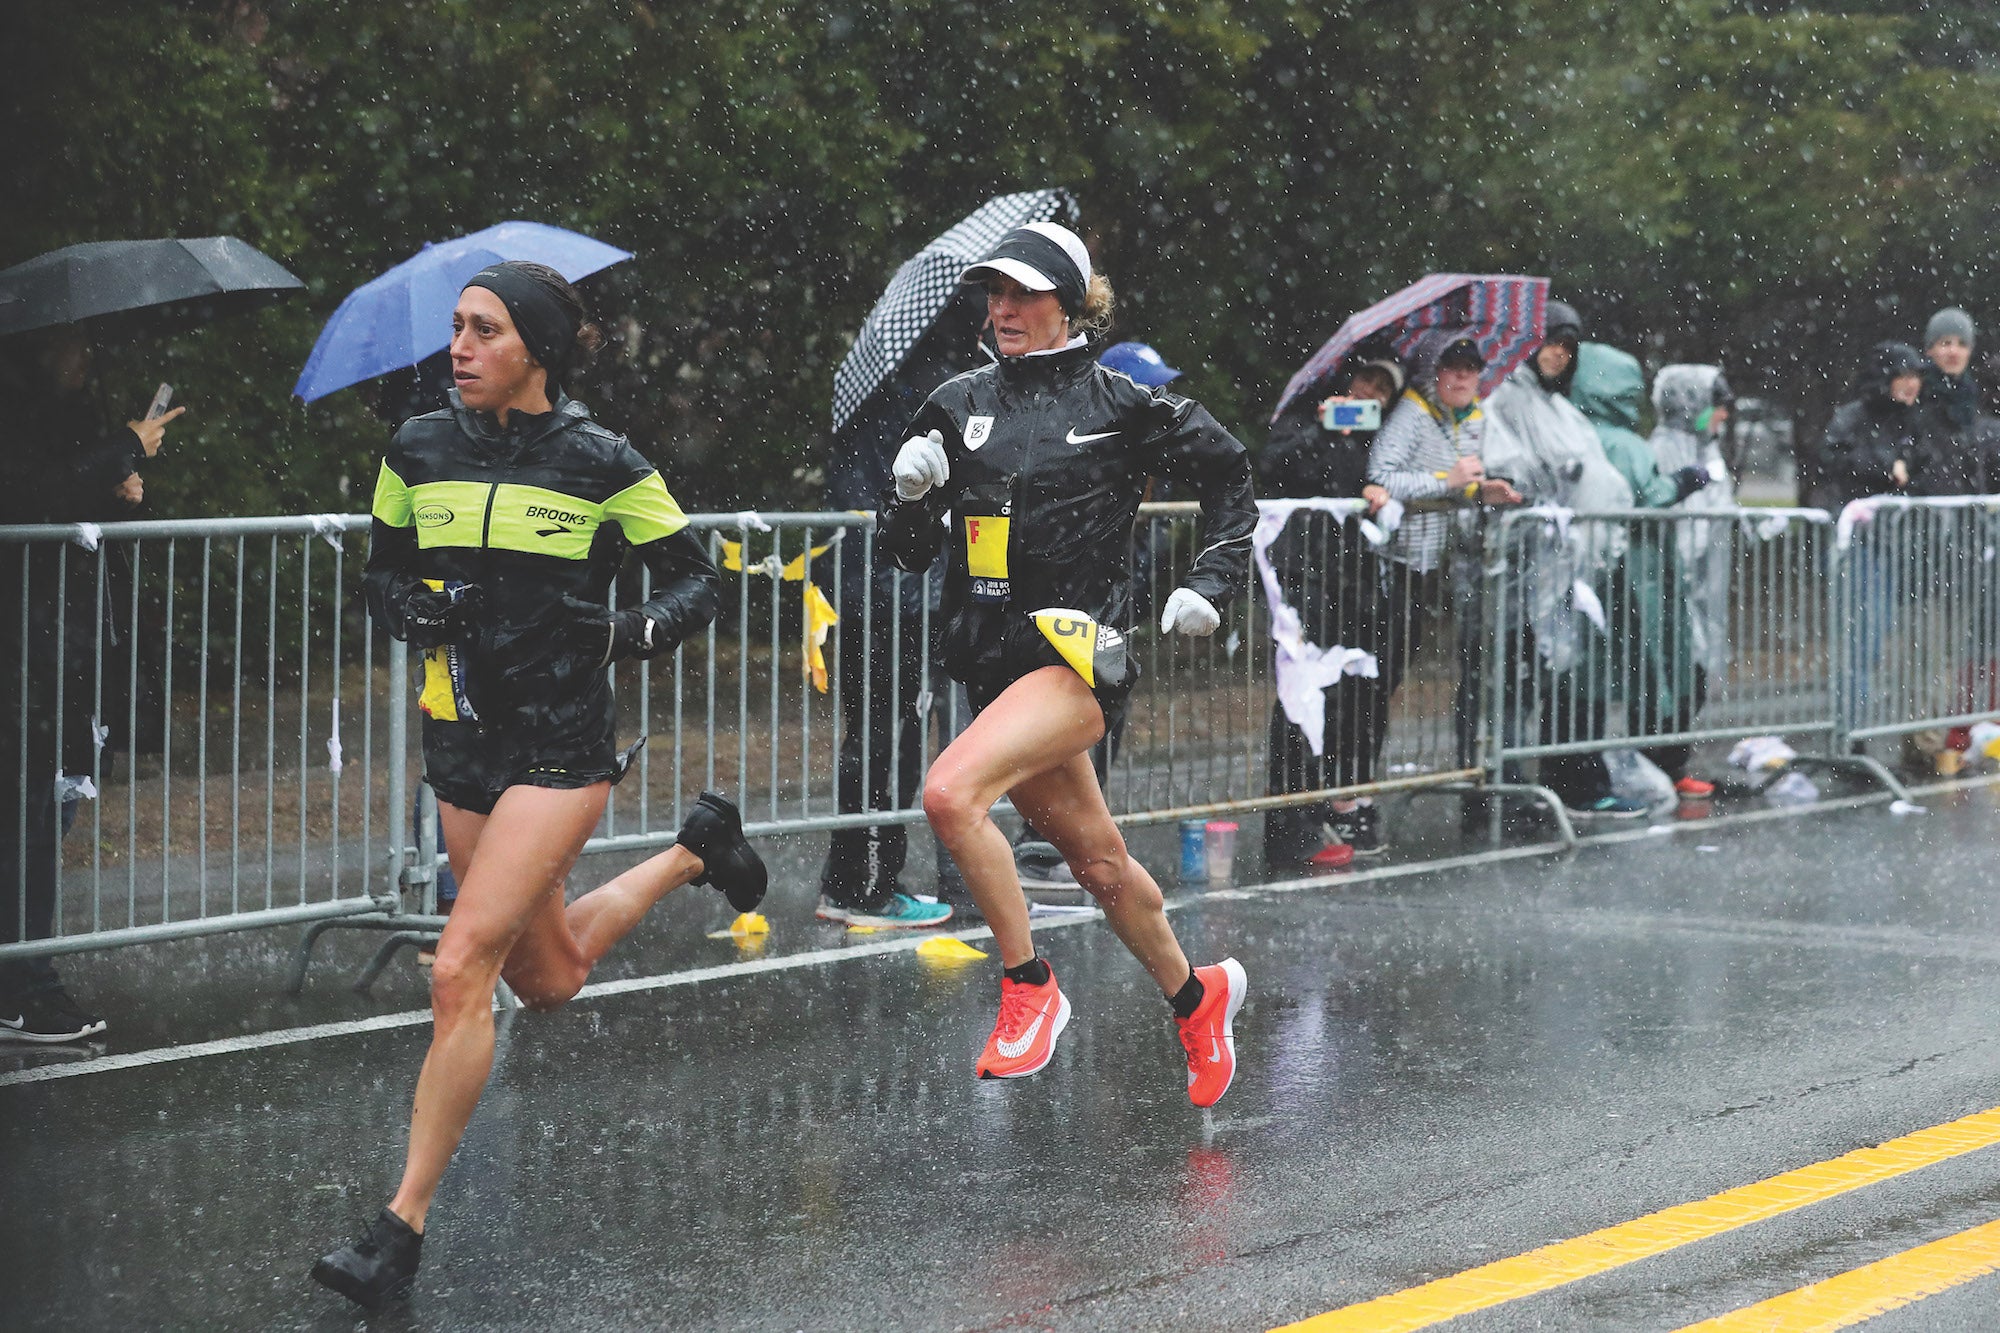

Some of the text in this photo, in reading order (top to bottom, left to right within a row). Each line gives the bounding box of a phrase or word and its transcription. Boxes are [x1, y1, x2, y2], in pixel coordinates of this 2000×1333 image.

[525, 506, 589, 525] BROOKS
[969, 520, 980, 544] F
[1053, 618, 1088, 639] 5
